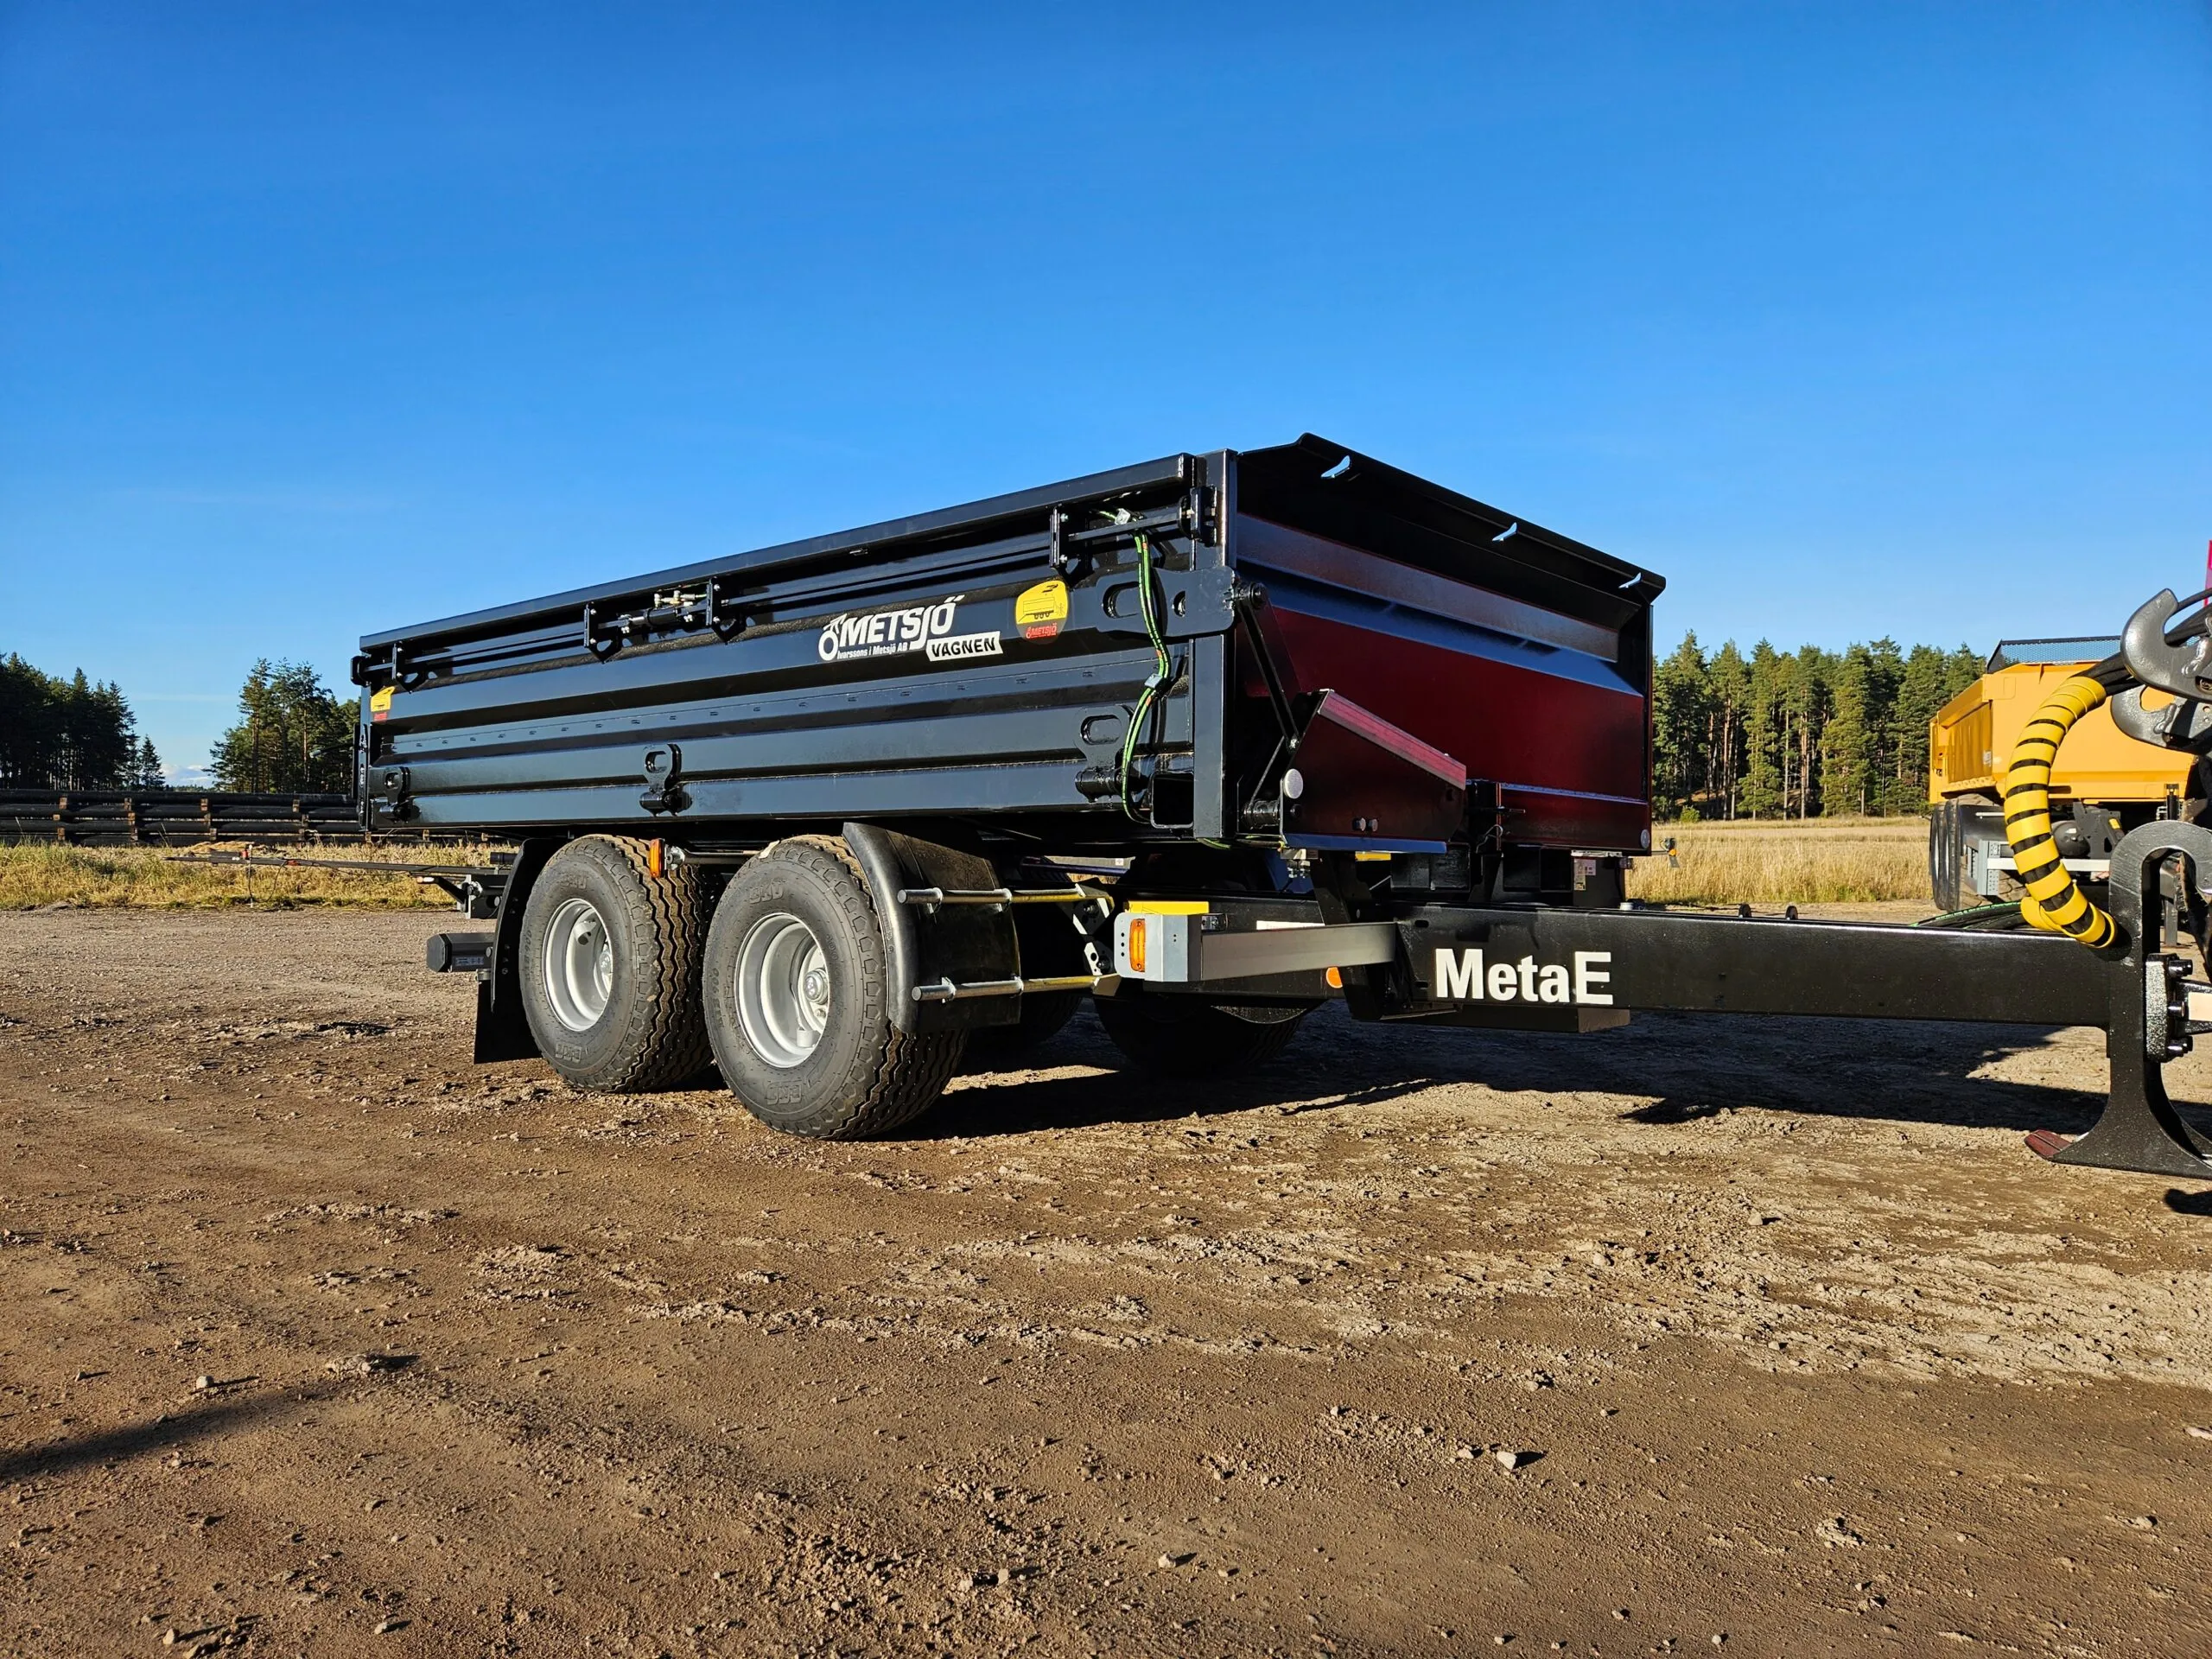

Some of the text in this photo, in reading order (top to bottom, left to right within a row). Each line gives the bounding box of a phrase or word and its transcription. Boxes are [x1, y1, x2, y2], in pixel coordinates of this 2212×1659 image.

[839, 594, 965, 650] METSJÖ
[873, 643, 896, 655] Metsjö
[897, 641, 908, 652] AB
[931, 636, 997, 658] VAGNEN
[1434, 948, 1614, 1006] MetaE
